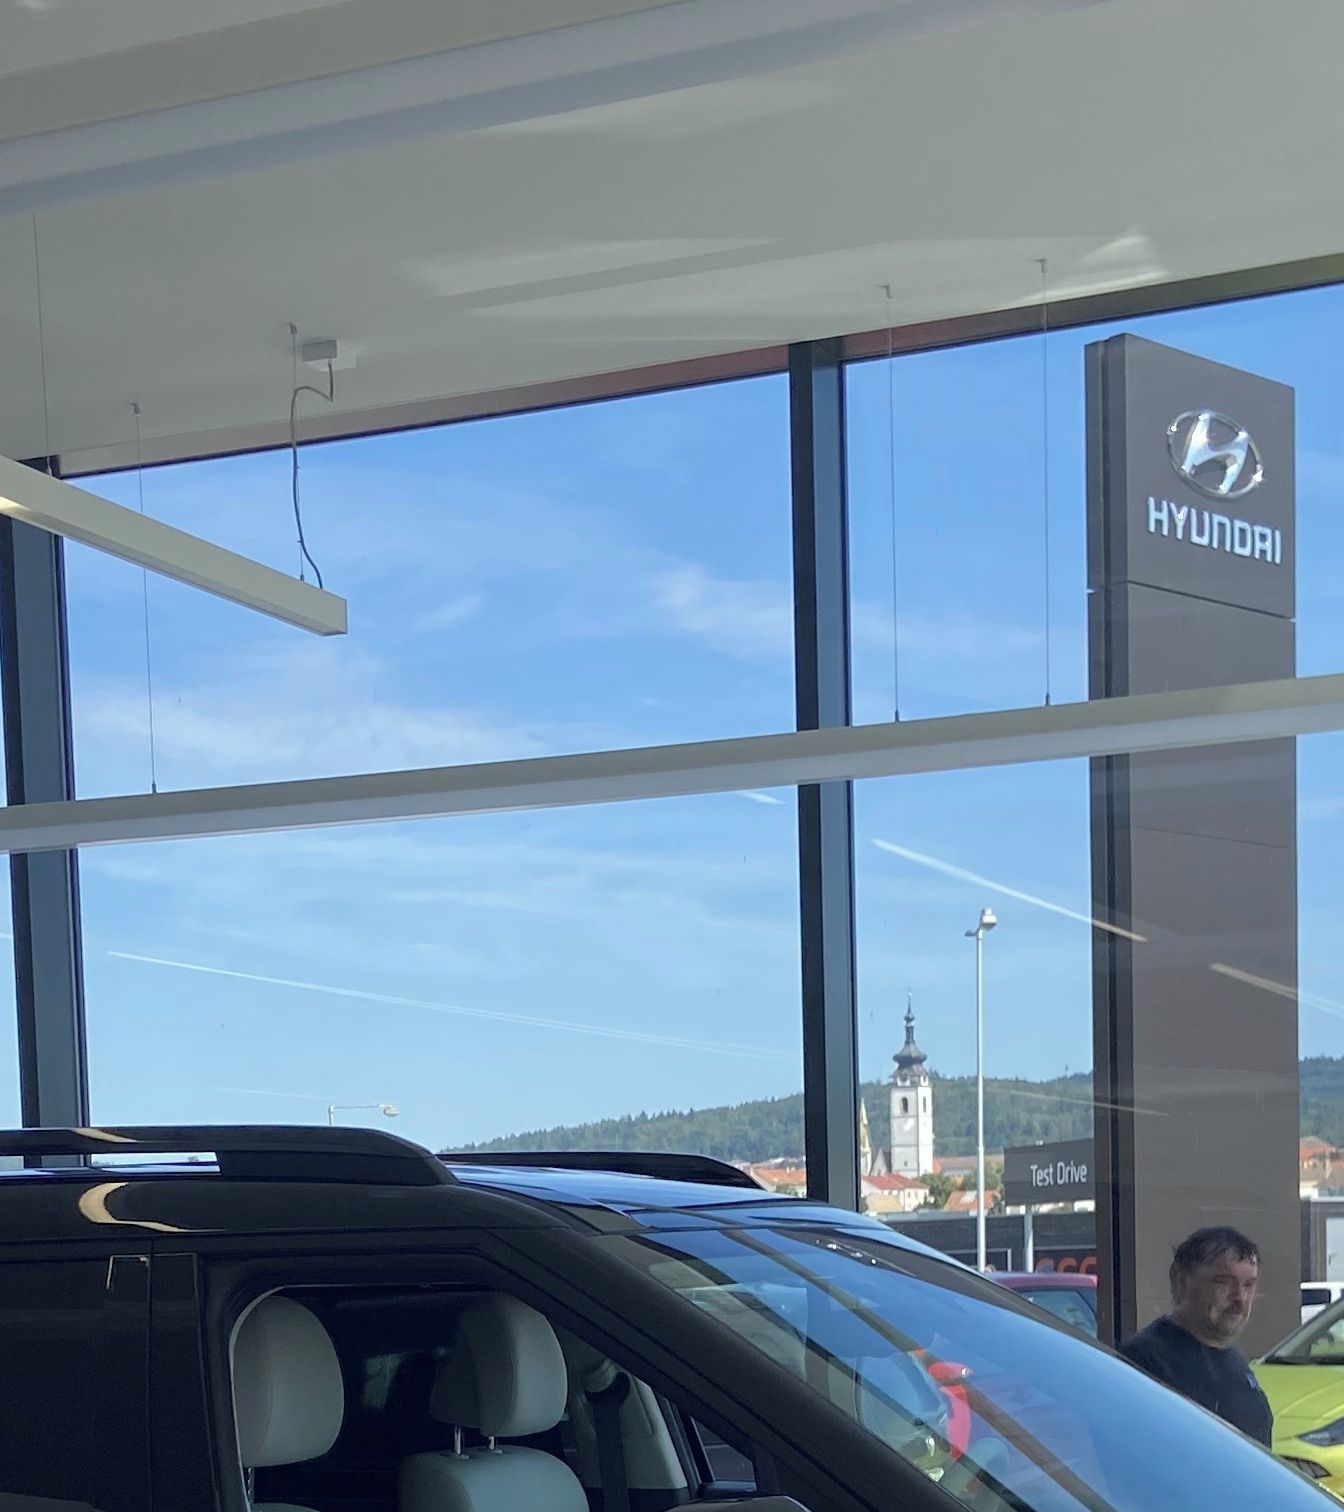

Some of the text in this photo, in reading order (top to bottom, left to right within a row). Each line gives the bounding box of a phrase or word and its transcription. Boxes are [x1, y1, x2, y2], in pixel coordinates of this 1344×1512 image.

[1147, 496, 1282, 565] HYUNDAI
[1030, 1160, 1088, 1187] Test Drive
